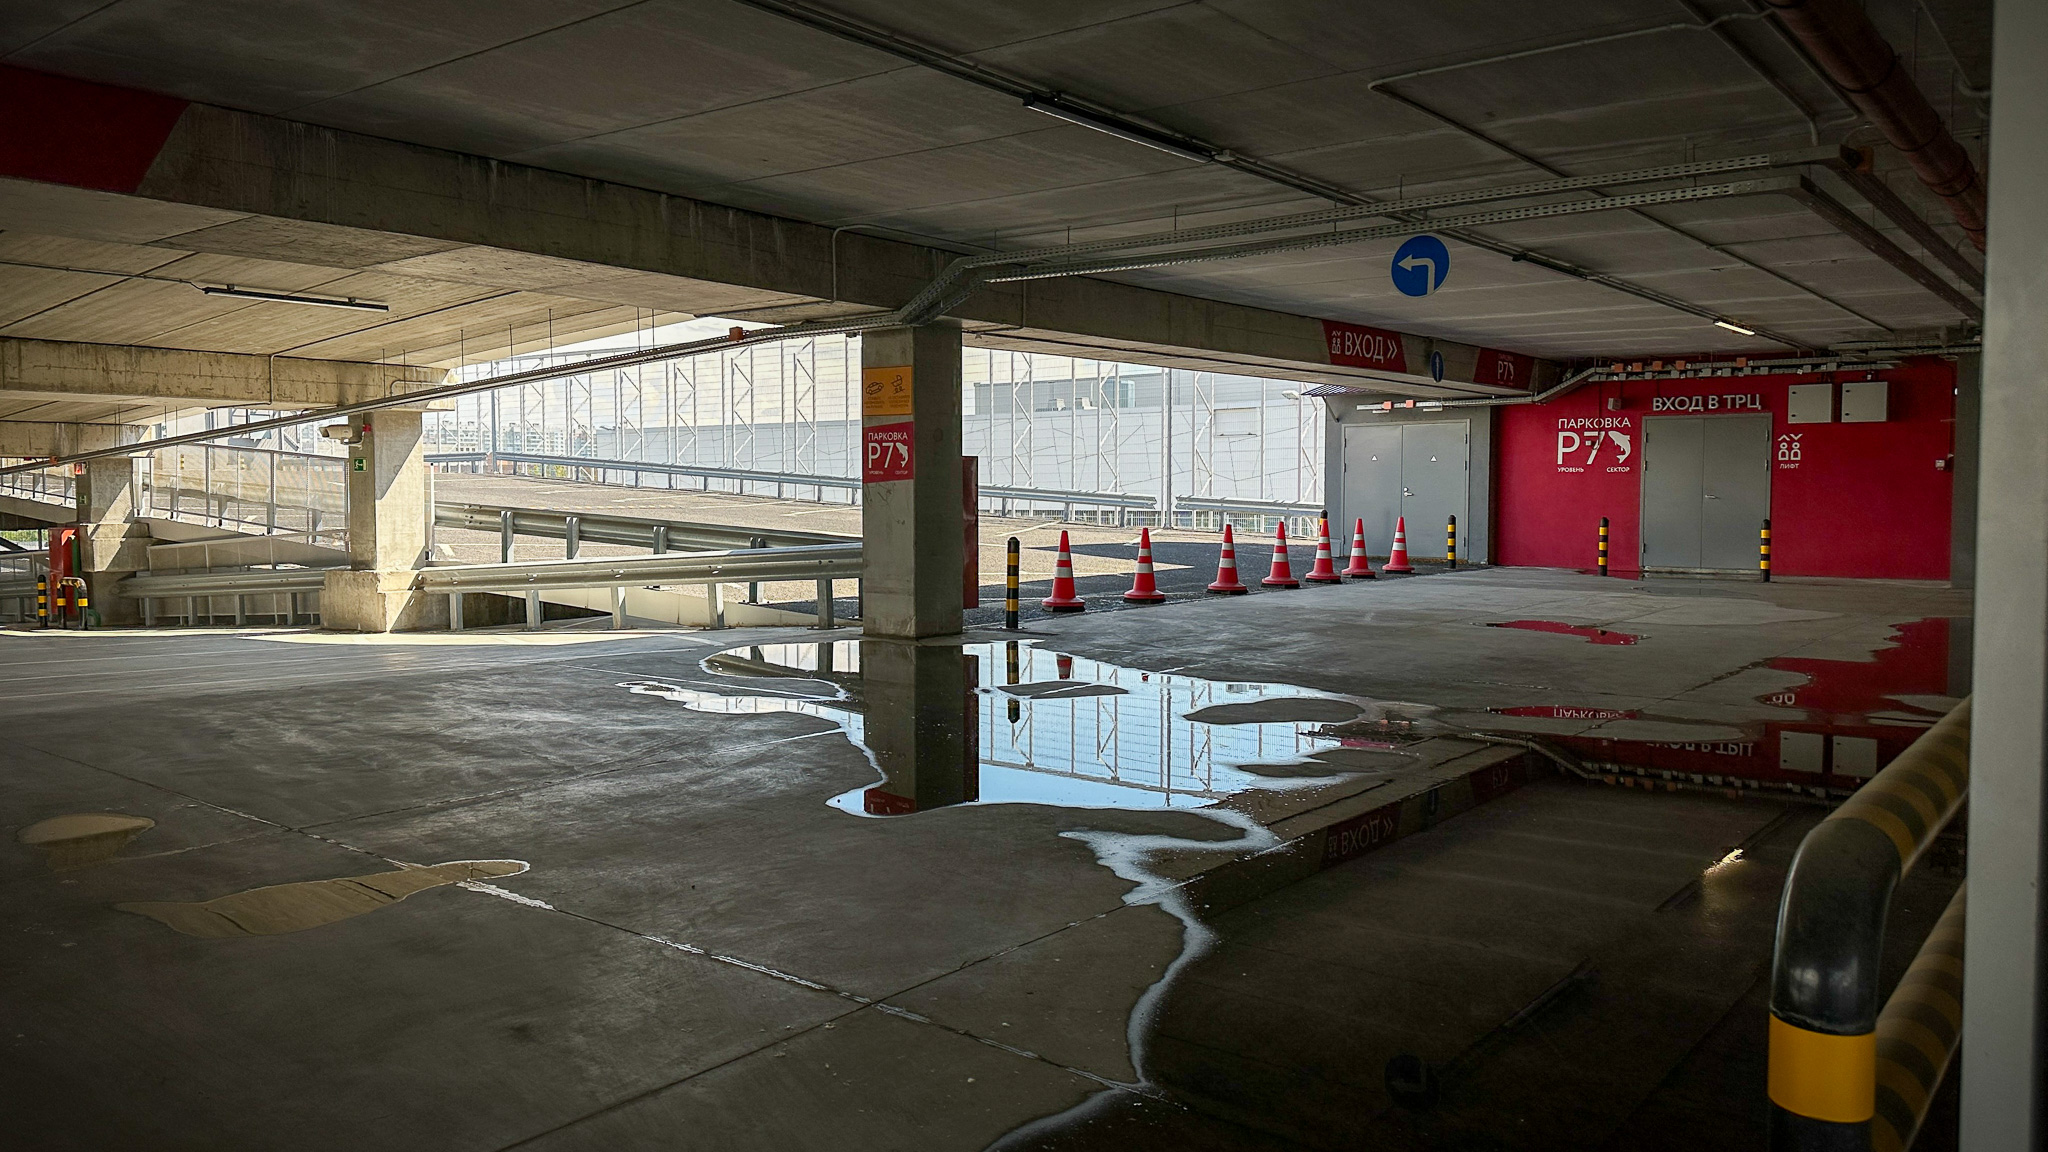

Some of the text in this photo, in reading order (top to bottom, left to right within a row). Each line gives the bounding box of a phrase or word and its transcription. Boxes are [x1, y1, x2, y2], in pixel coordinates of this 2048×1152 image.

[1345, 331, 1384, 364] ВХОД
[1652, 394, 1761, 412] ВХОД В ТРЦ
[1558, 417, 1631, 429] ПАРКОВКА
[868, 432, 908, 441] ПАРКОВКА
